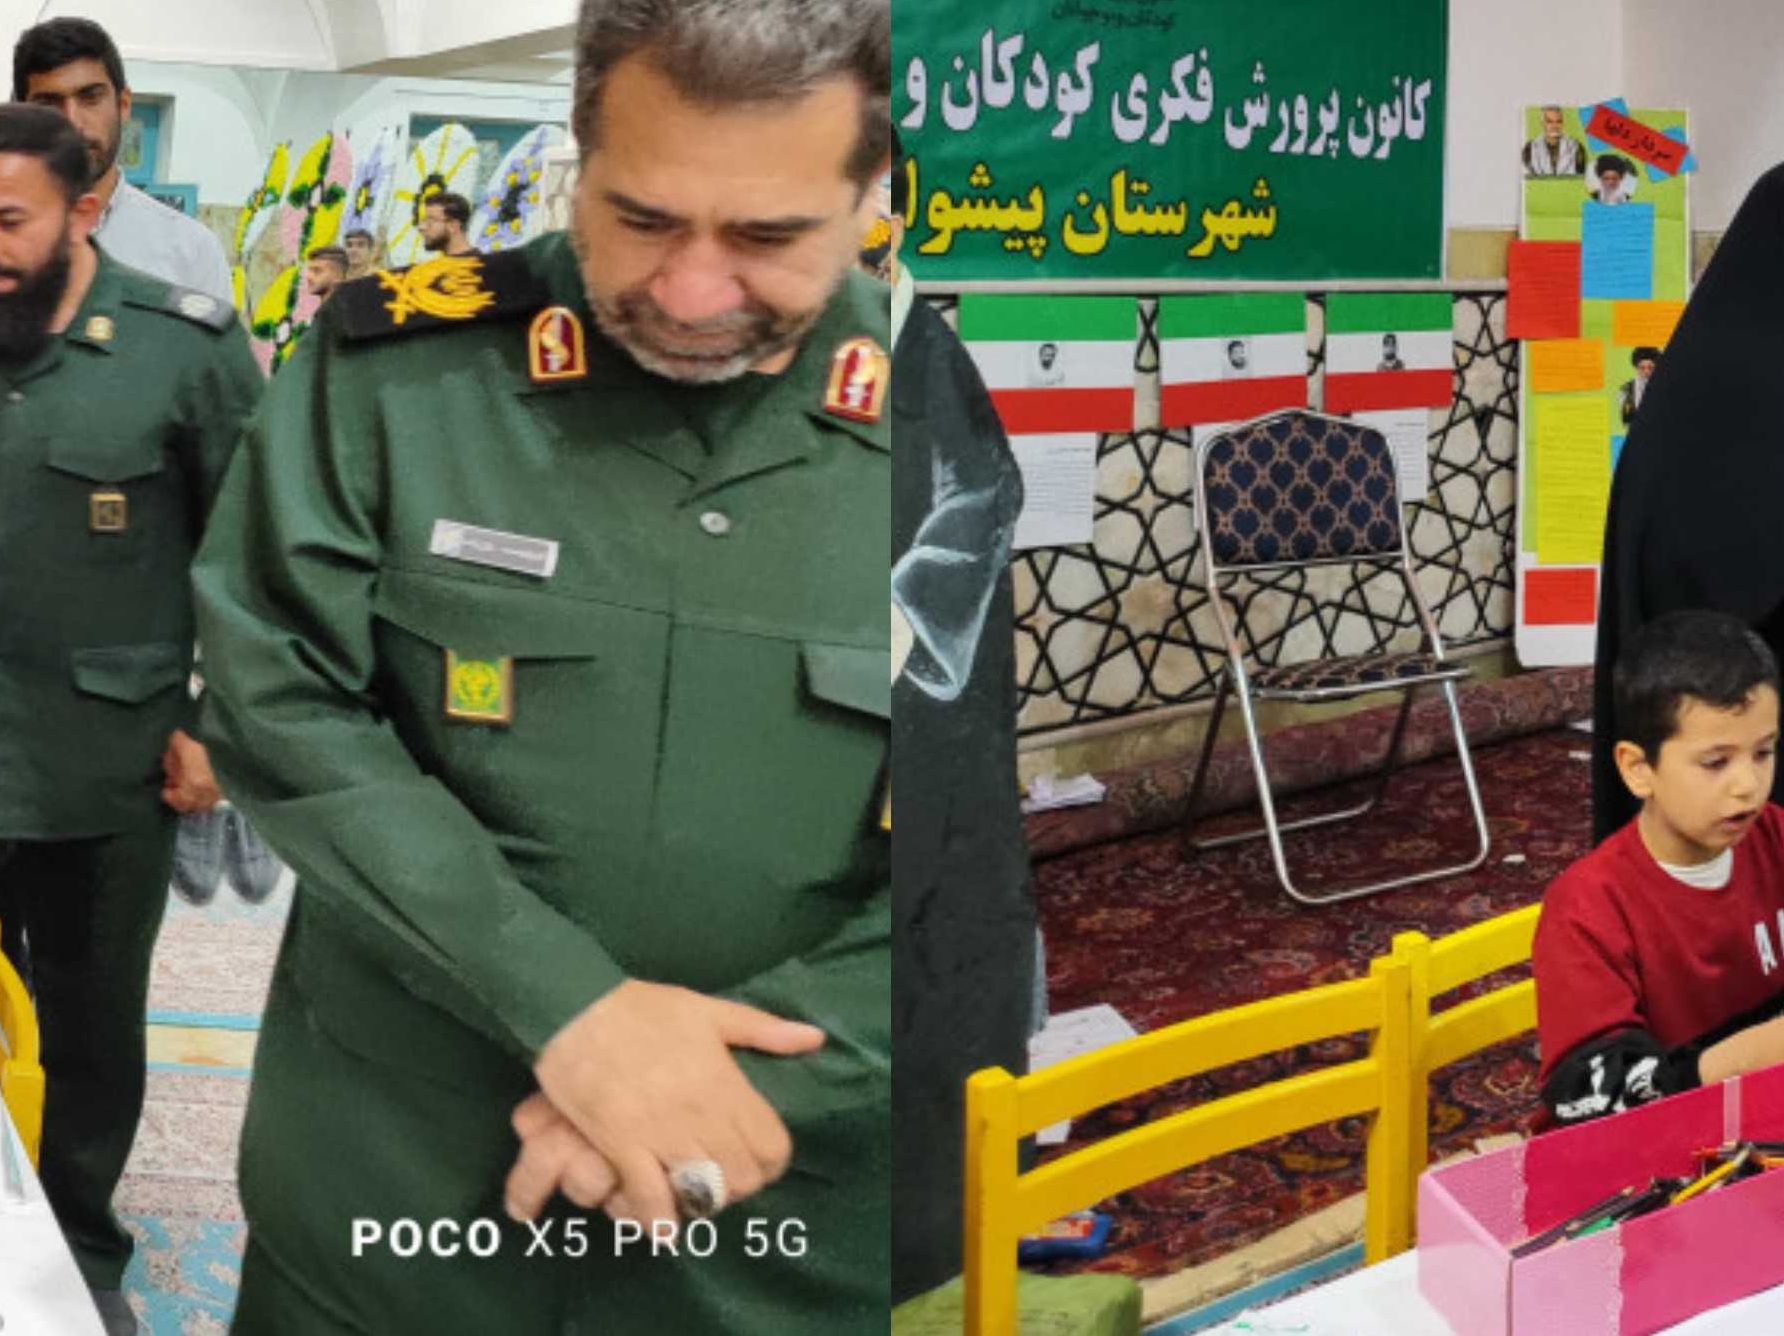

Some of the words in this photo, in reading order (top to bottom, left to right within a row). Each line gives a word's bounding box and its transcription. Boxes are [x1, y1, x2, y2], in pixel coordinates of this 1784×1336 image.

[900, 55, 928, 129] و
[940, 28, 1101, 140] کودکان
[1110, 46, 1215, 145] فکری
[1223, 60, 1341, 158] پرورش
[1347, 74, 1432, 158] کانون
